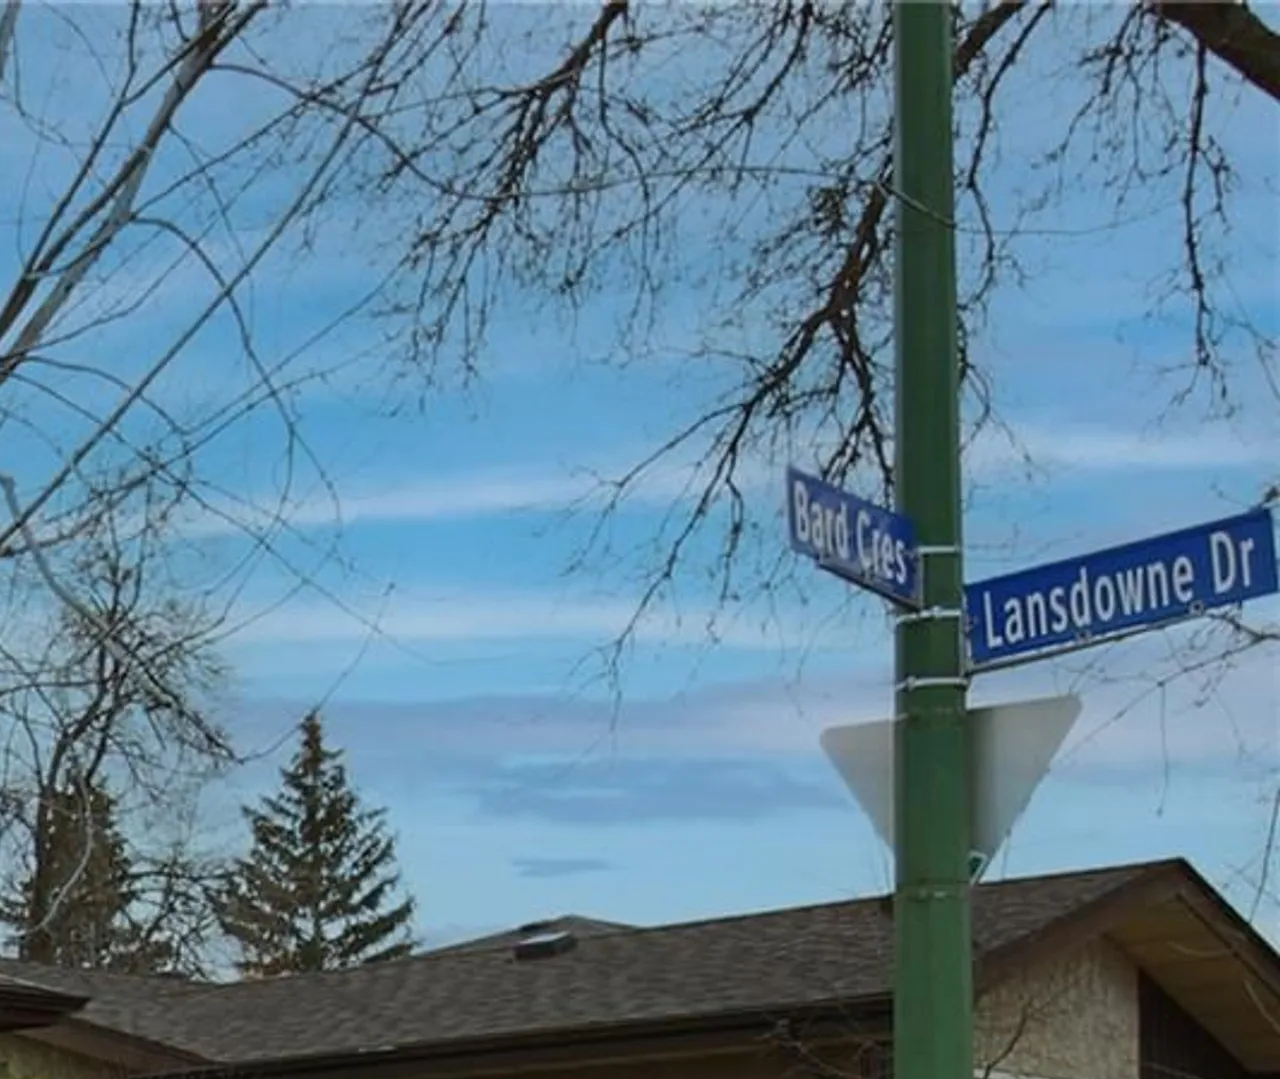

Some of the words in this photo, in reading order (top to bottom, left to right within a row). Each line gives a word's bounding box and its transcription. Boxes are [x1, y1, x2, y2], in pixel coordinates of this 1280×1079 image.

[794, 481, 847, 546] Bard
[856, 509, 908, 585] Cres
[984, 562, 1195, 650] Lansdowne
[1210, 529, 1256, 593] Dr
